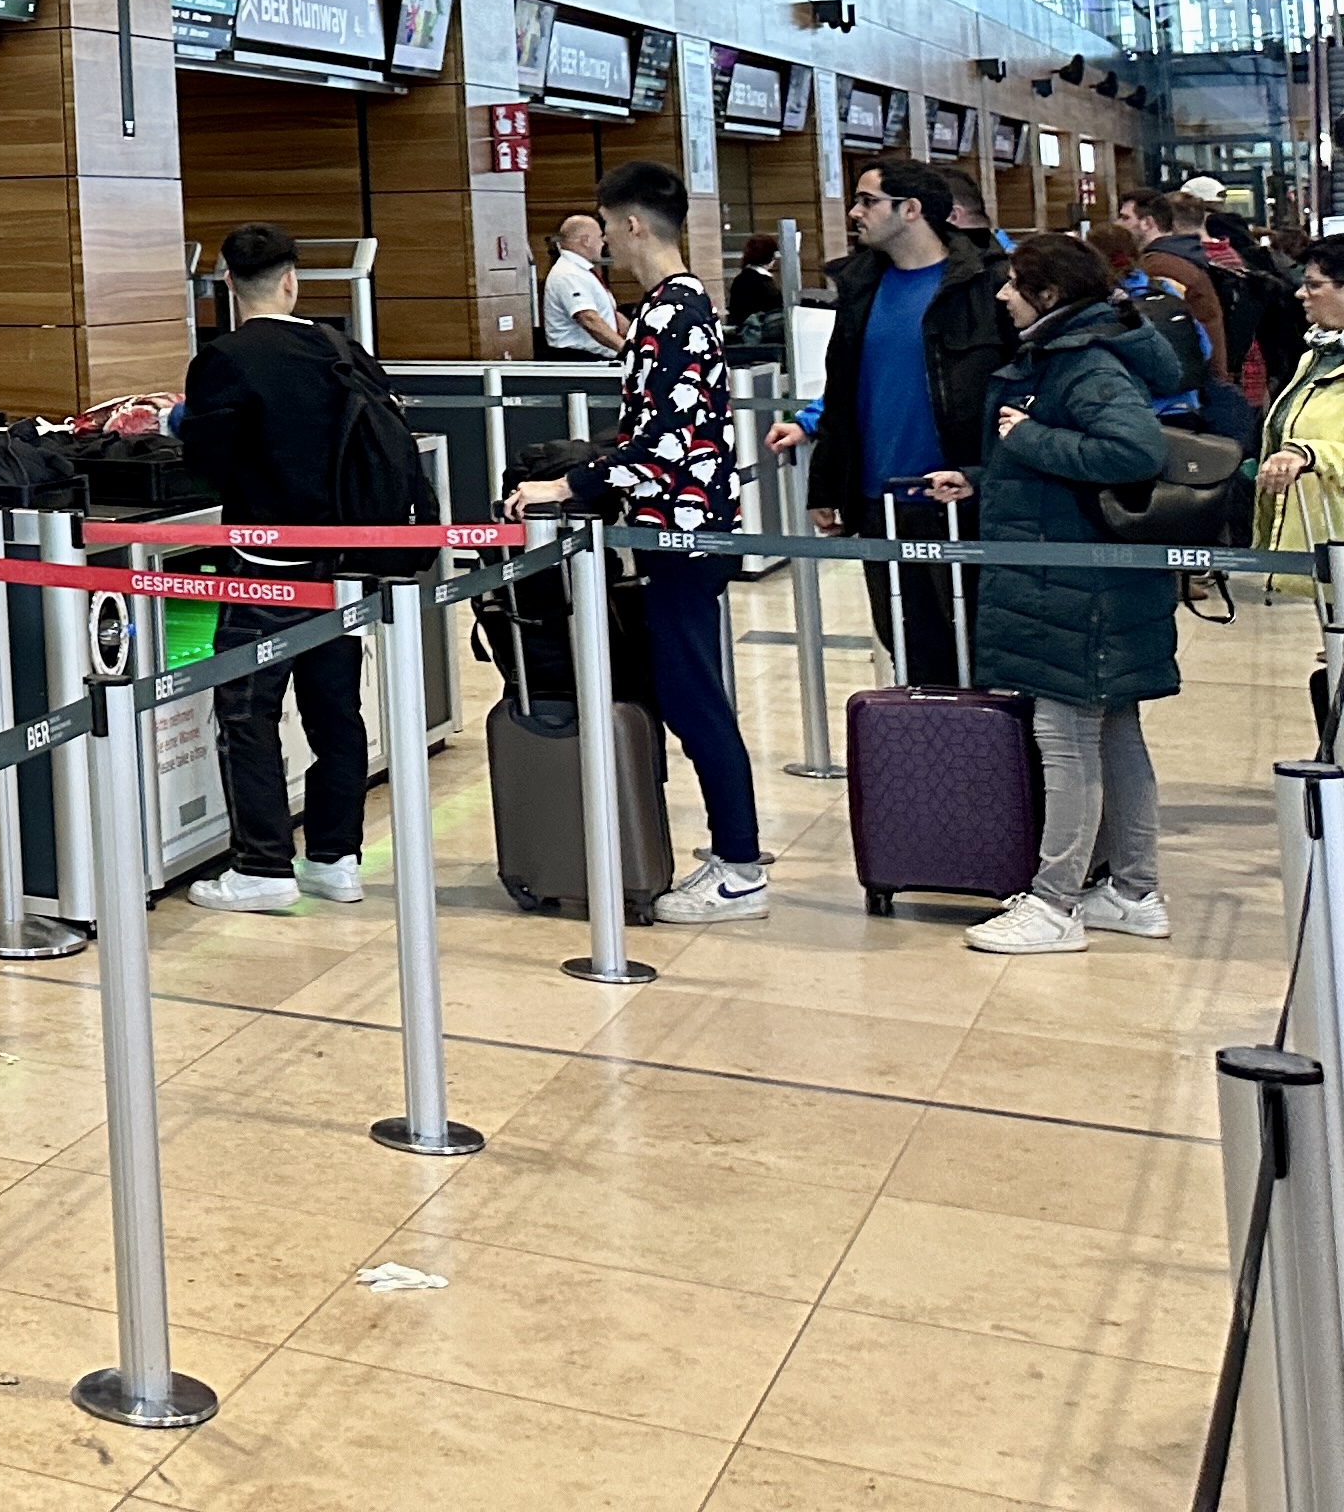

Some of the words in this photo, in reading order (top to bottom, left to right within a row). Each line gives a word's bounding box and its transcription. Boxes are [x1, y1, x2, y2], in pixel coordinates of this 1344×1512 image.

[228, 528, 279, 545] STOP
[446, 528, 498, 545] STOP
[657, 531, 695, 549] BER
[901, 542, 942, 560] BER
[1166, 548, 1211, 568] BER
[131, 574, 215, 597] GESPERRT
[227, 582, 296, 602] CLOSED
[26, 719, 51, 751] BER
